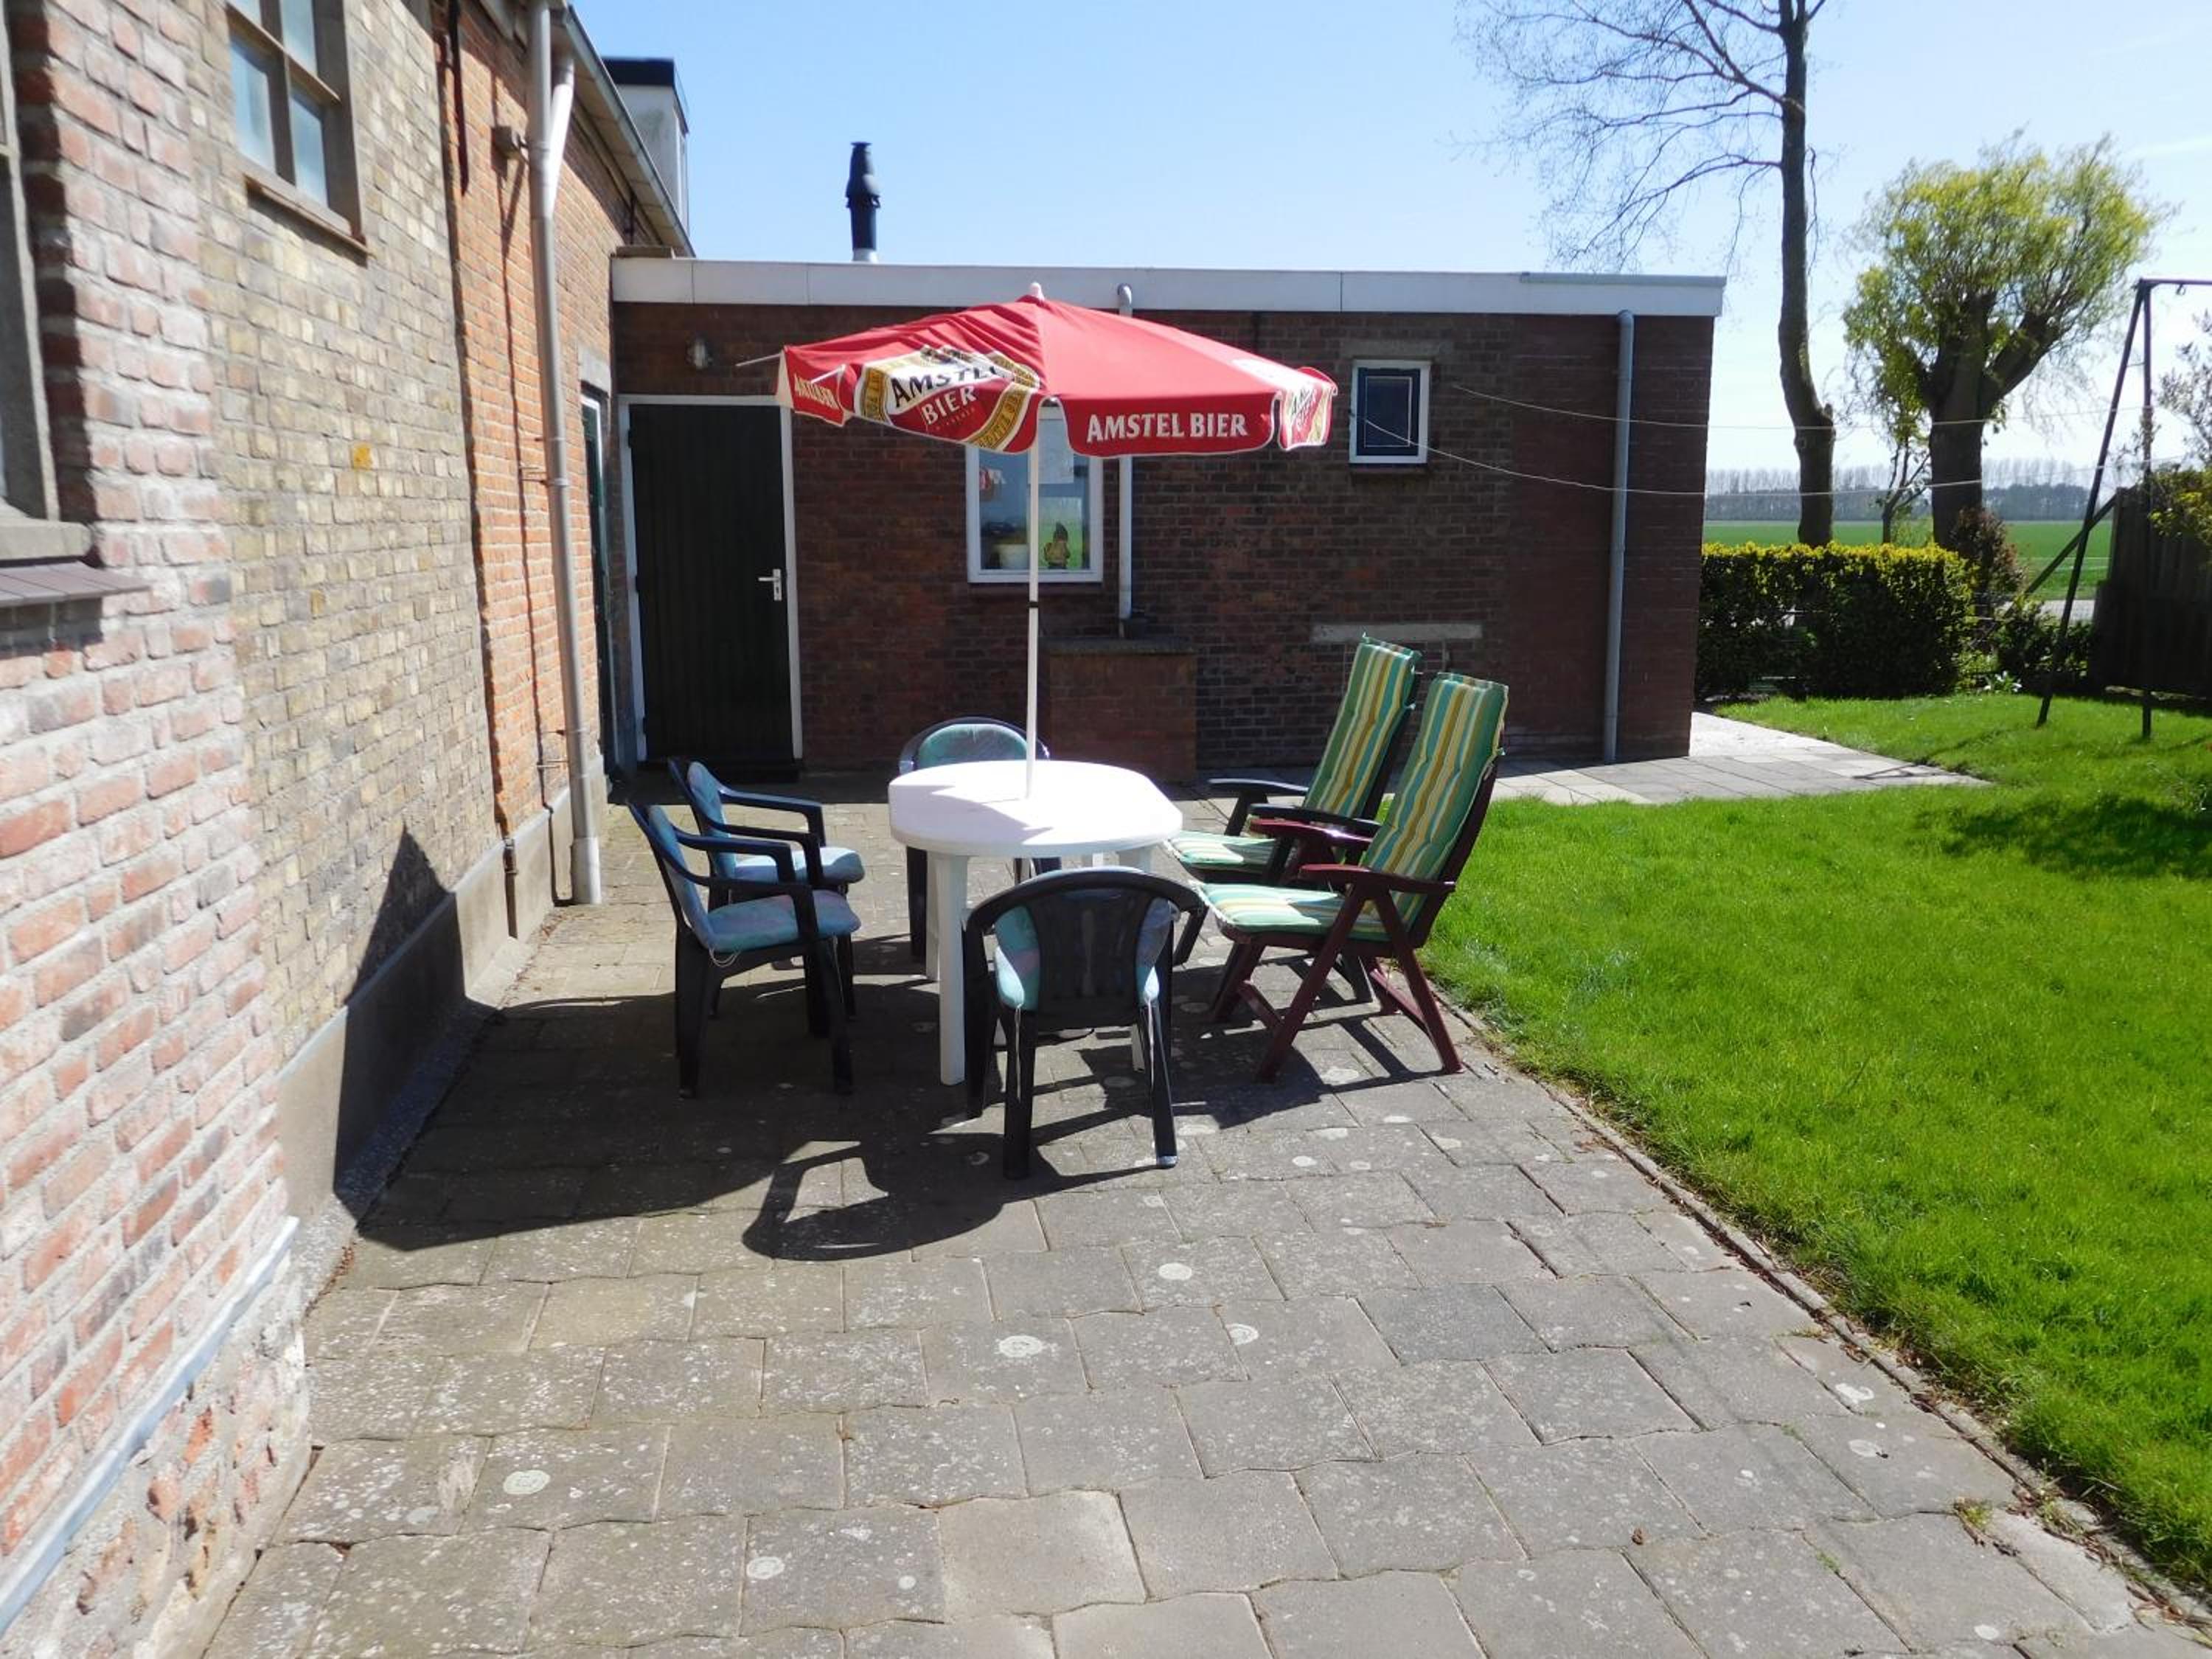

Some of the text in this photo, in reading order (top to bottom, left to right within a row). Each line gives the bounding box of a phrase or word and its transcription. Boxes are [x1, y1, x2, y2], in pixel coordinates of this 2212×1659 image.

[891, 366, 1000, 408] AMST
[922, 386, 977, 425] BIER
[1086, 412, 1249, 444] AMSTEL BIER
